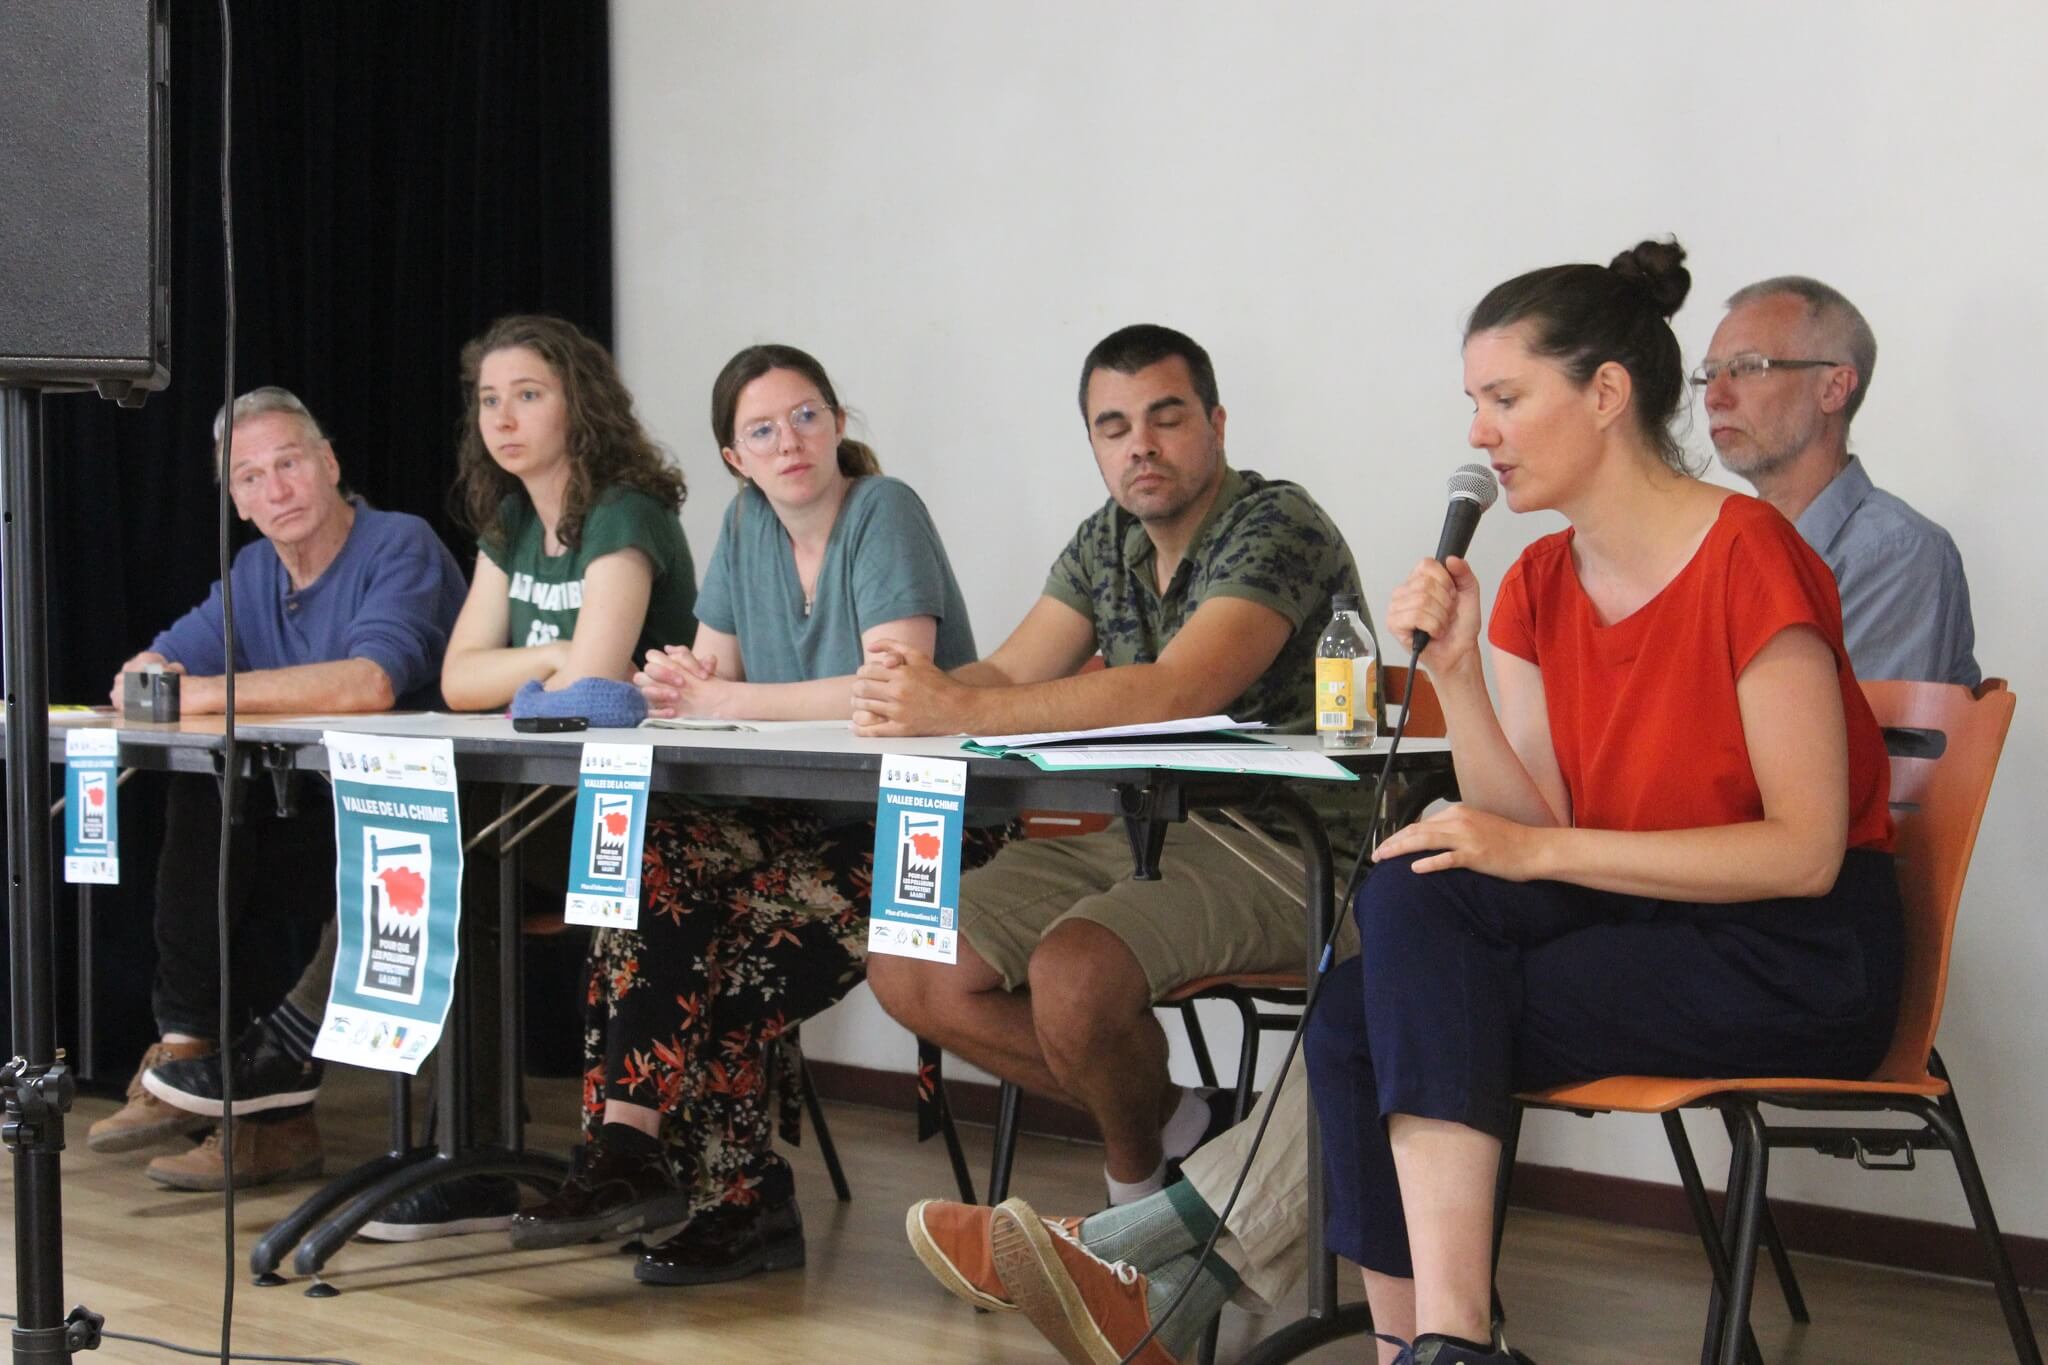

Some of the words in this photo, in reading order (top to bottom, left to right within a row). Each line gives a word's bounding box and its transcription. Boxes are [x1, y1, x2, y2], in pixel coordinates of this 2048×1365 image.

[342, 795, 380, 815] VALLEE
[379, 800, 395, 817] DE
[394, 802, 408, 819] LA
[408, 804, 449, 823] CHIMIE
[887, 793, 914, 806] VALLEE
[913, 796, 924, 807] DE
[924, 797, 934, 808] LA
[934, 799, 960, 811] CHIMIE
